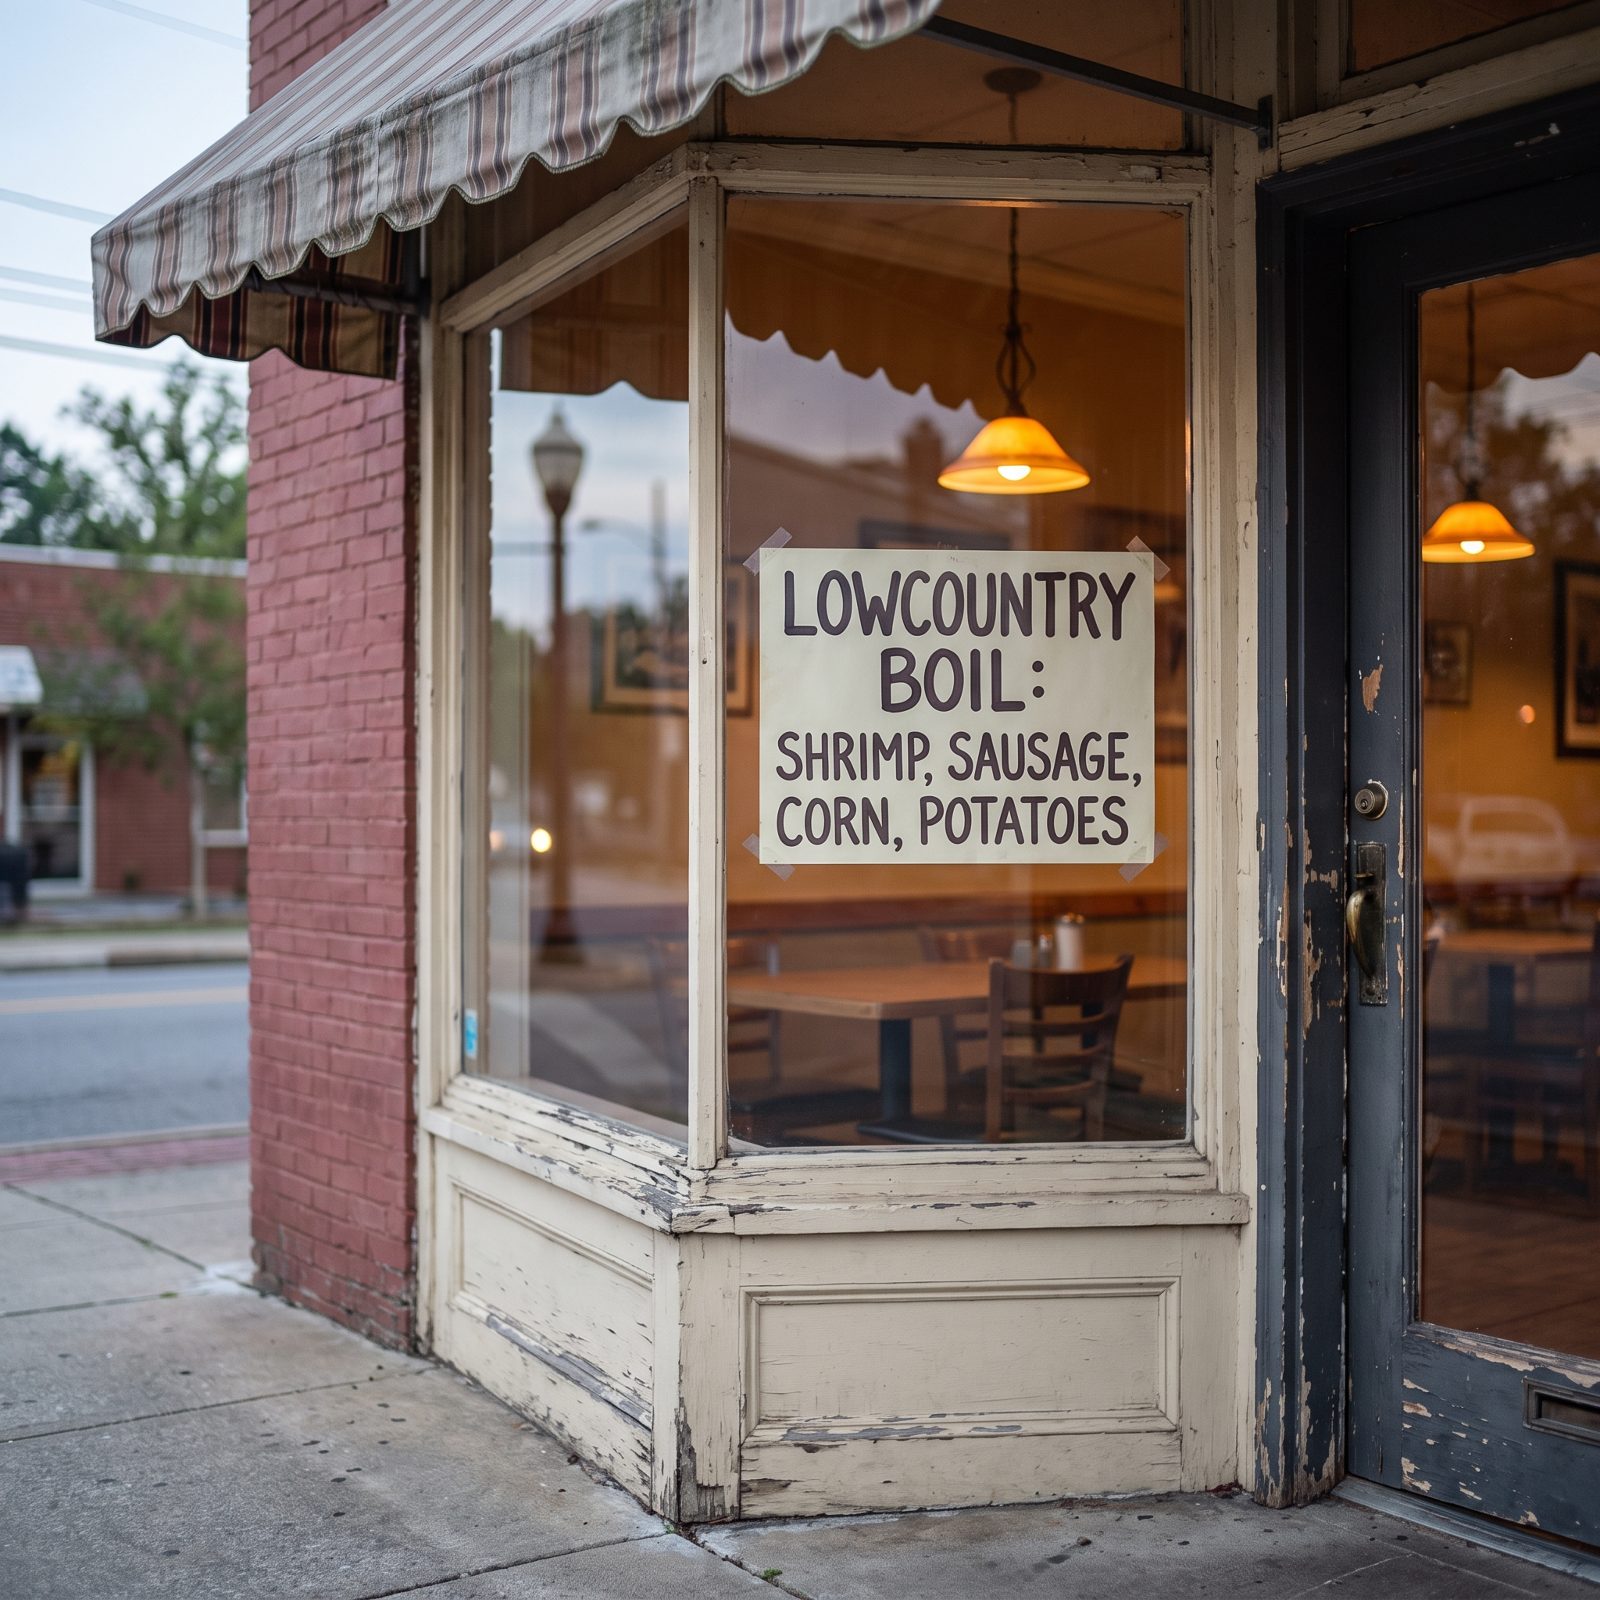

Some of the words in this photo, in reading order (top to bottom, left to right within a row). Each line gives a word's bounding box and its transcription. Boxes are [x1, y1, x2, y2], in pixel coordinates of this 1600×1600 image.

[783, 569, 1137, 641] LOWCOUNTRY
[880, 646, 1046, 714] BOIL:
[775, 730, 933, 787] SHRIMP,
[947, 730, 1142, 788] SAUSAGE,
[776, 796, 903, 853] CORN,
[919, 795, 1129, 847] POTATOES
